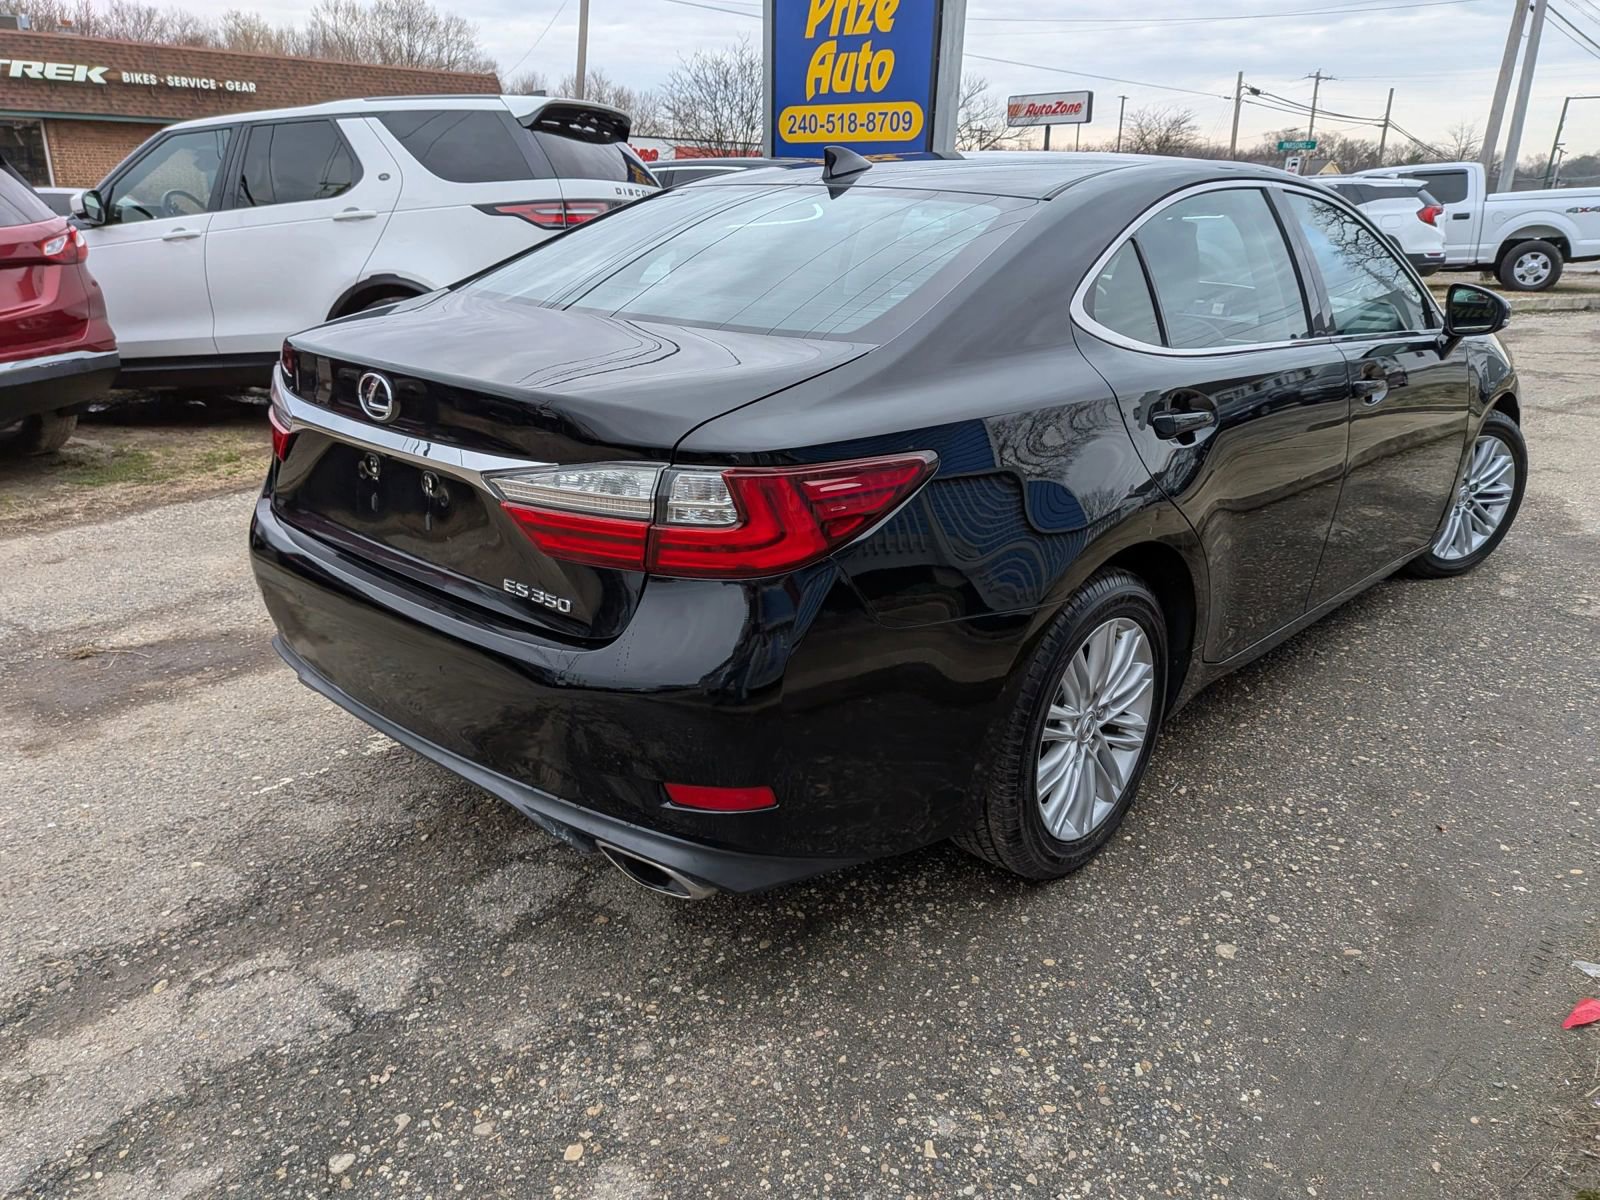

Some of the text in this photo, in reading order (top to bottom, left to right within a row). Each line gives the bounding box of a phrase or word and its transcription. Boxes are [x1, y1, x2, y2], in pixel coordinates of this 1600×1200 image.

[804, 0, 901, 39] Prize
[121, 71, 257, 93] BIKES SERVICE GEAR
[805, 40, 895, 102] Auto
[787, 110, 913, 135] 240-518-8709
[1024, 100, 1082, 118] AutoZone
[503, 578, 571, 613] ES 350
